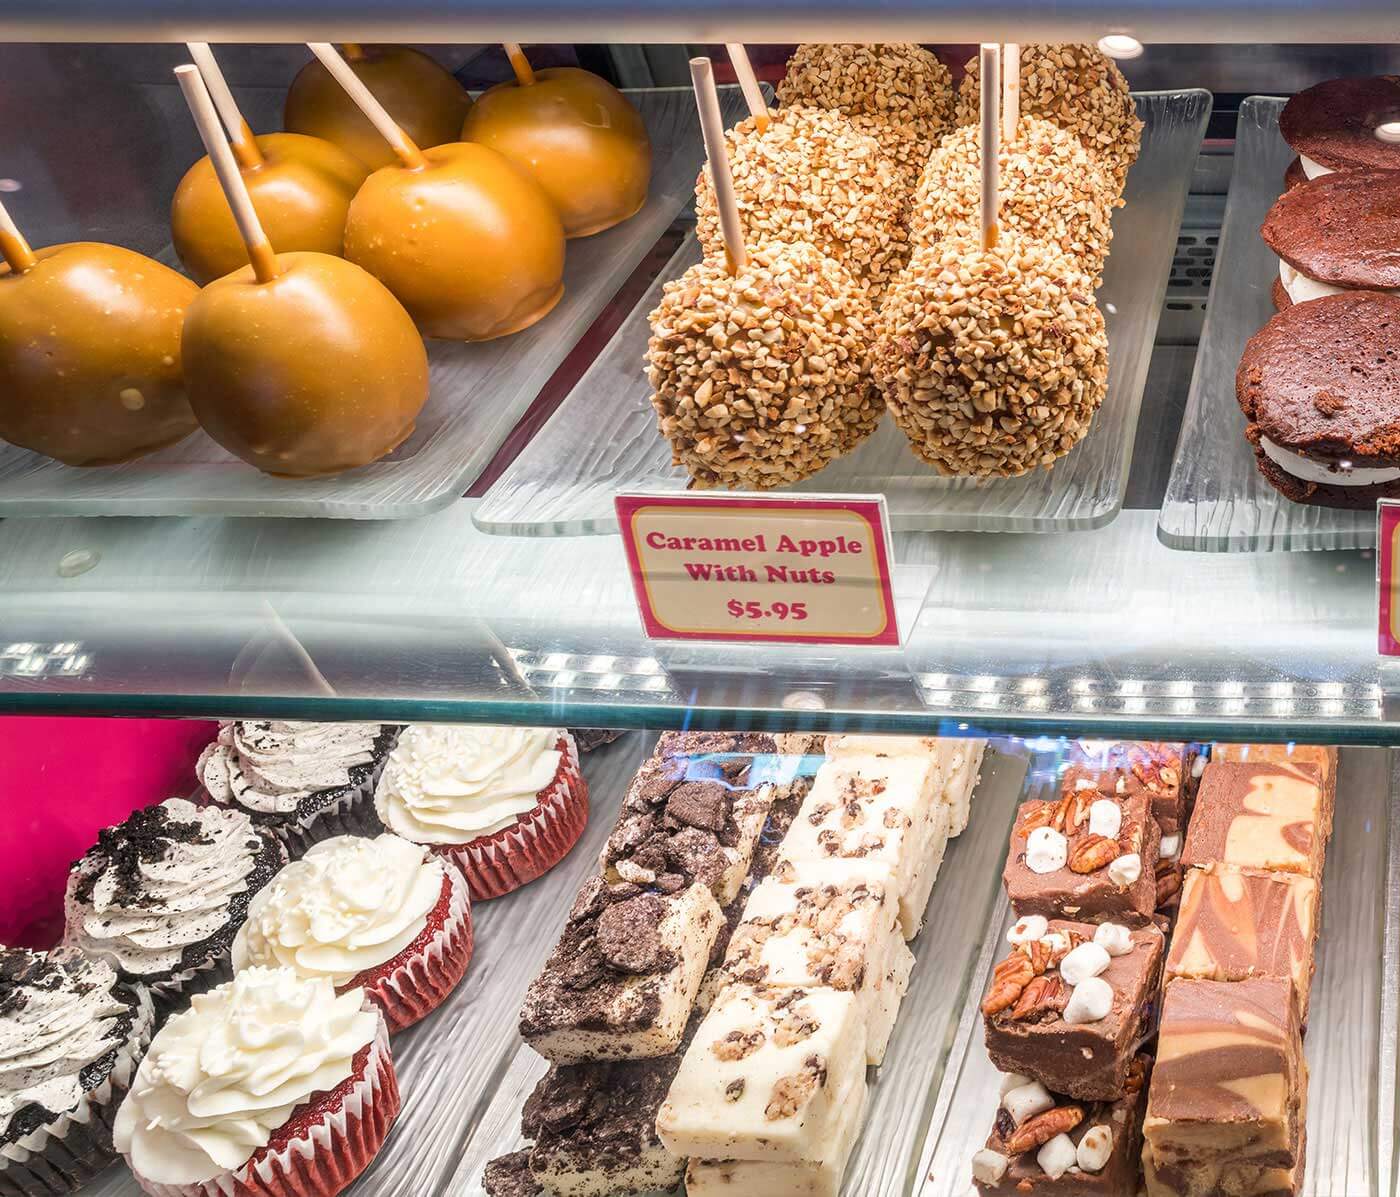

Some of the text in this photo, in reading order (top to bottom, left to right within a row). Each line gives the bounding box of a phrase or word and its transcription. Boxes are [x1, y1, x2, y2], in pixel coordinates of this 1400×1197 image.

[646, 531, 863, 558] Caramel Apple
[685, 561, 834, 585] With Nuts
[727, 599, 808, 621] $5.95
